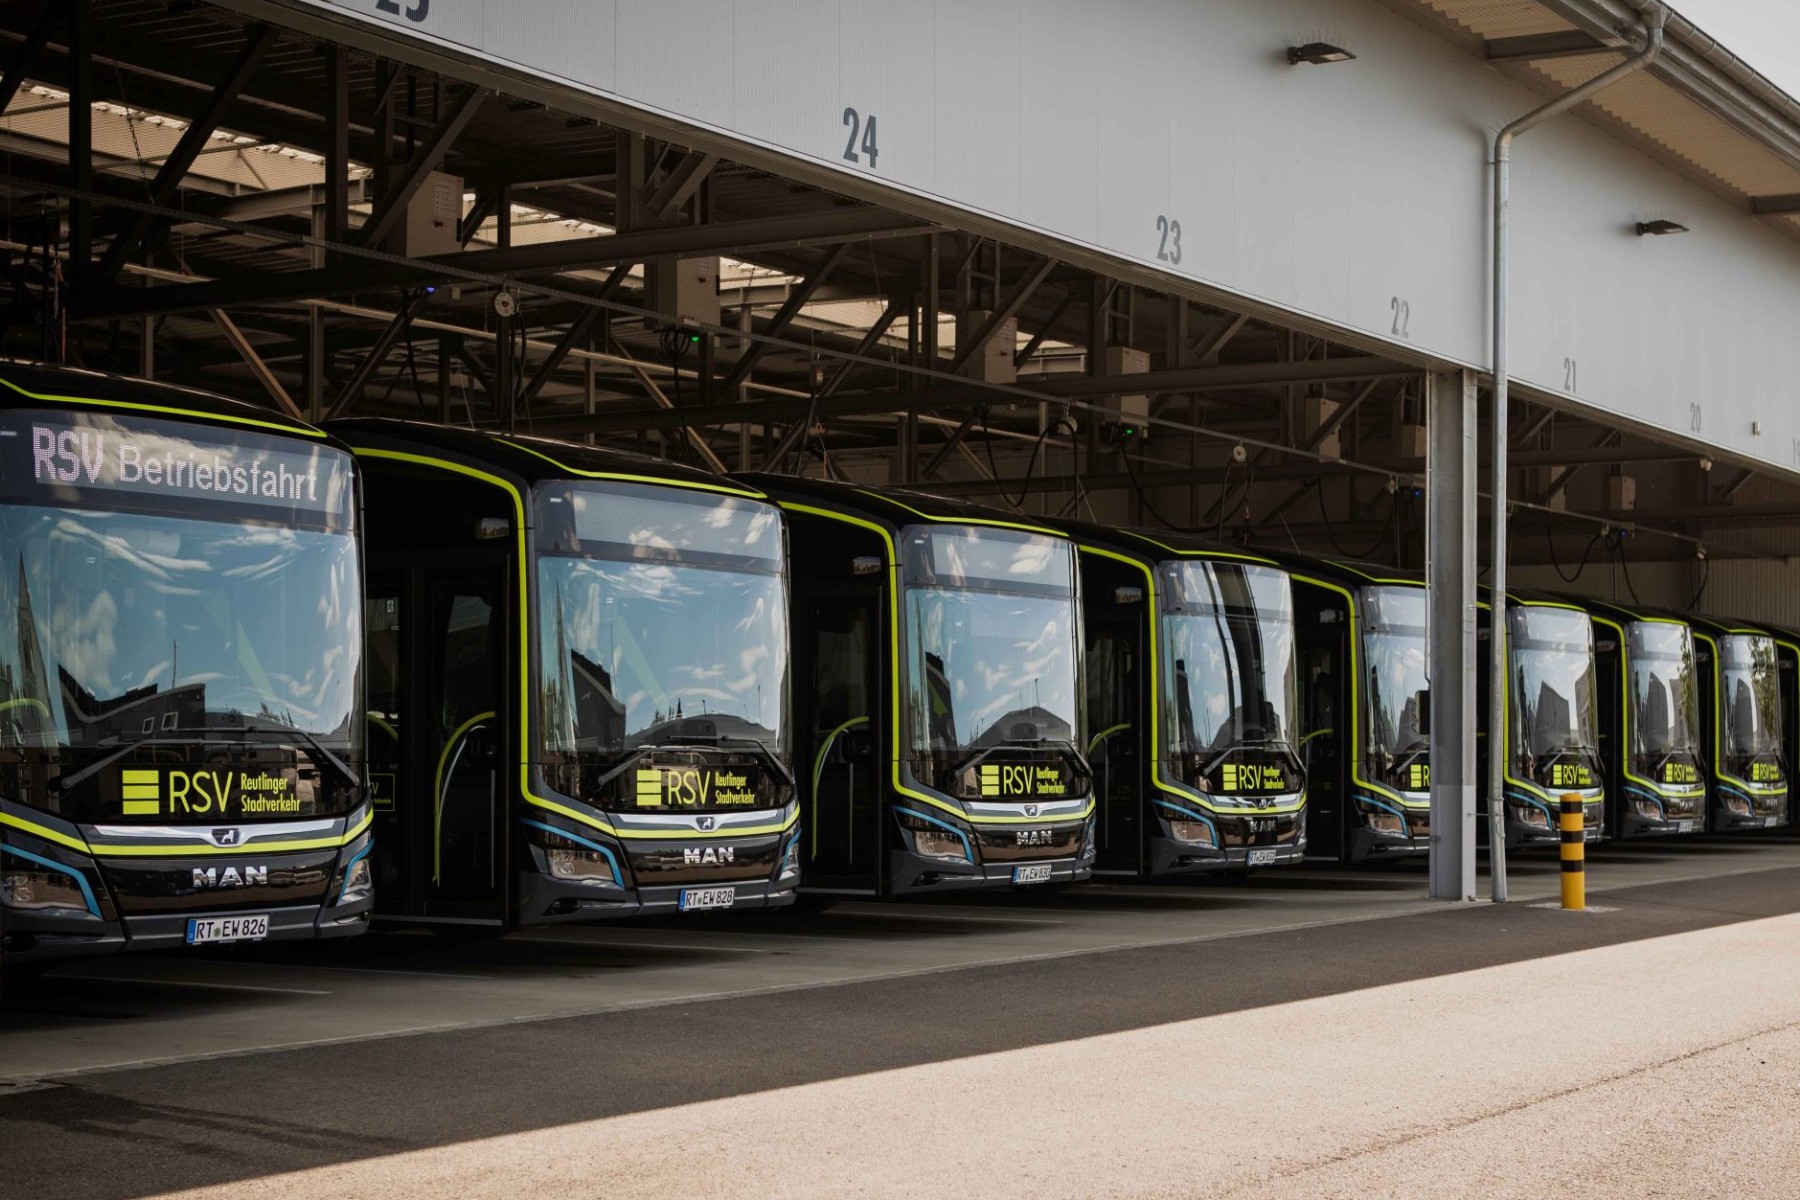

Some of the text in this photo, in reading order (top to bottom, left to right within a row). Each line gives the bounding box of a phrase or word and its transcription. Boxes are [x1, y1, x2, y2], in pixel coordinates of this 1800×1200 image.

[843, 107, 878, 169] 24
[1156, 214, 1182, 265] 23
[1391, 296, 1409, 338] 22
[1563, 357, 1576, 393] 21
[1690, 401, 1701, 434] 20
[32, 426, 317, 502] RSV Betriebsfahrt
[241, 772, 288, 795] Reutlinger
[715, 772, 746, 790] Reutlinger
[1003, 765, 1034, 795] RSV
[1239, 765, 1262, 789] RSV
[1563, 765, 1578, 785] RSV
[168, 771, 233, 813] RSV
[667, 771, 711, 805] RSV
[715, 789, 756, 804] Stadtverkehr
[241, 795, 300, 813] Stadtverkehr
[1016, 830, 1053, 846] MAN
[683, 846, 735, 865] MAN
[192, 865, 268, 888] MAN
[686, 890, 733, 906] RT EW 828
[196, 918, 266, 939] RT EW 826
